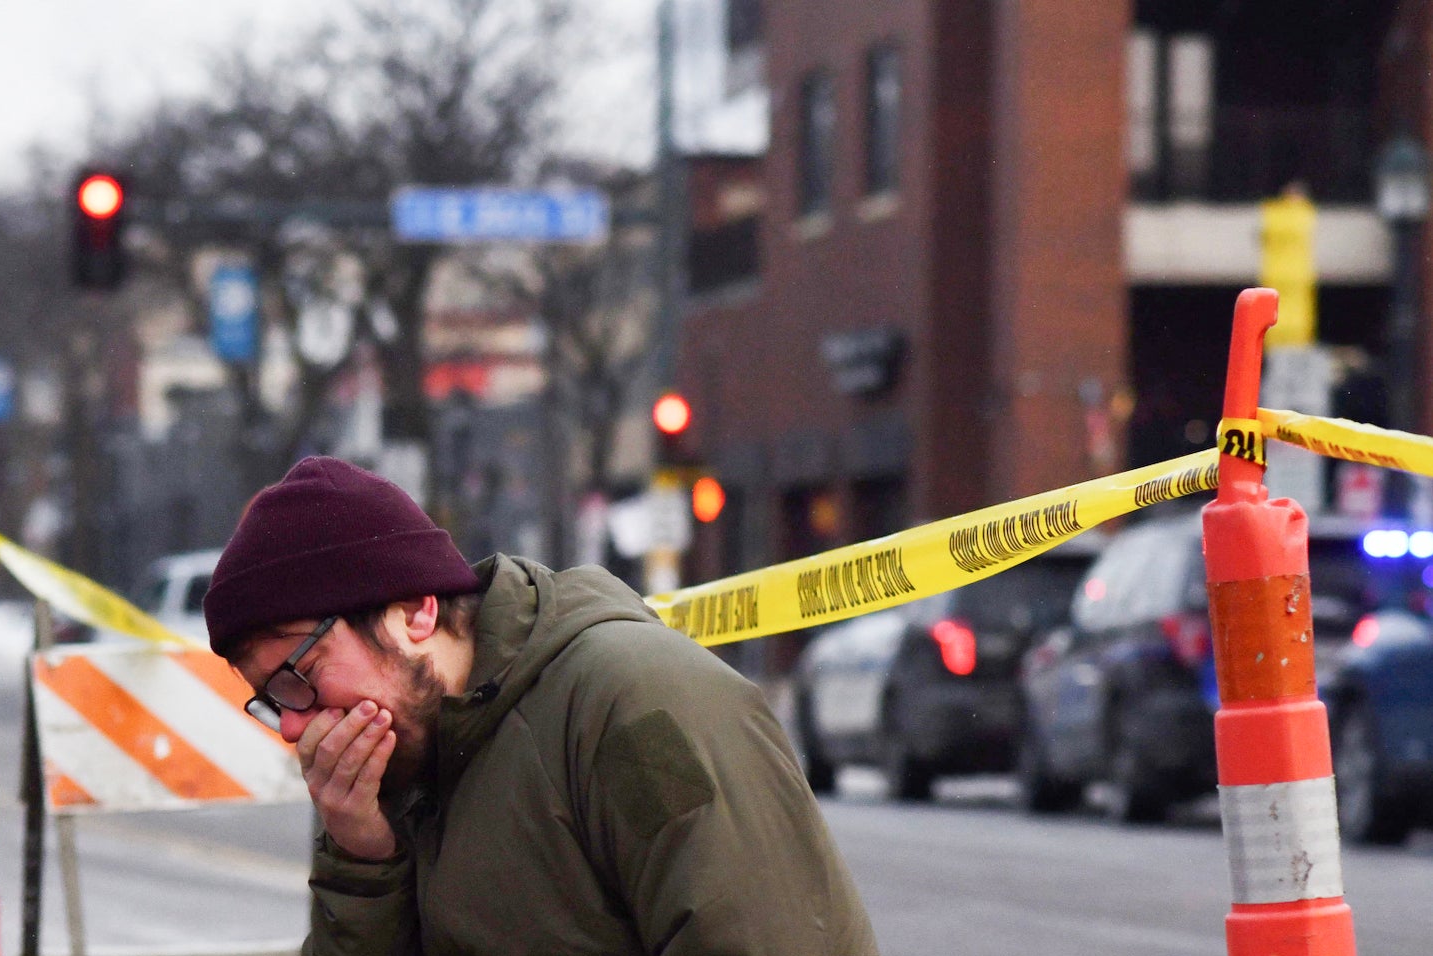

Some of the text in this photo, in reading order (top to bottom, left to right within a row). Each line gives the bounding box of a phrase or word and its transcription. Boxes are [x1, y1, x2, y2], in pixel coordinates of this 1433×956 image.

[1018, 509, 1049, 545] LINE
[1042, 499, 1084, 538] POLICE
[796, 546, 916, 619] POLICE LINE DO NOT CROSS
